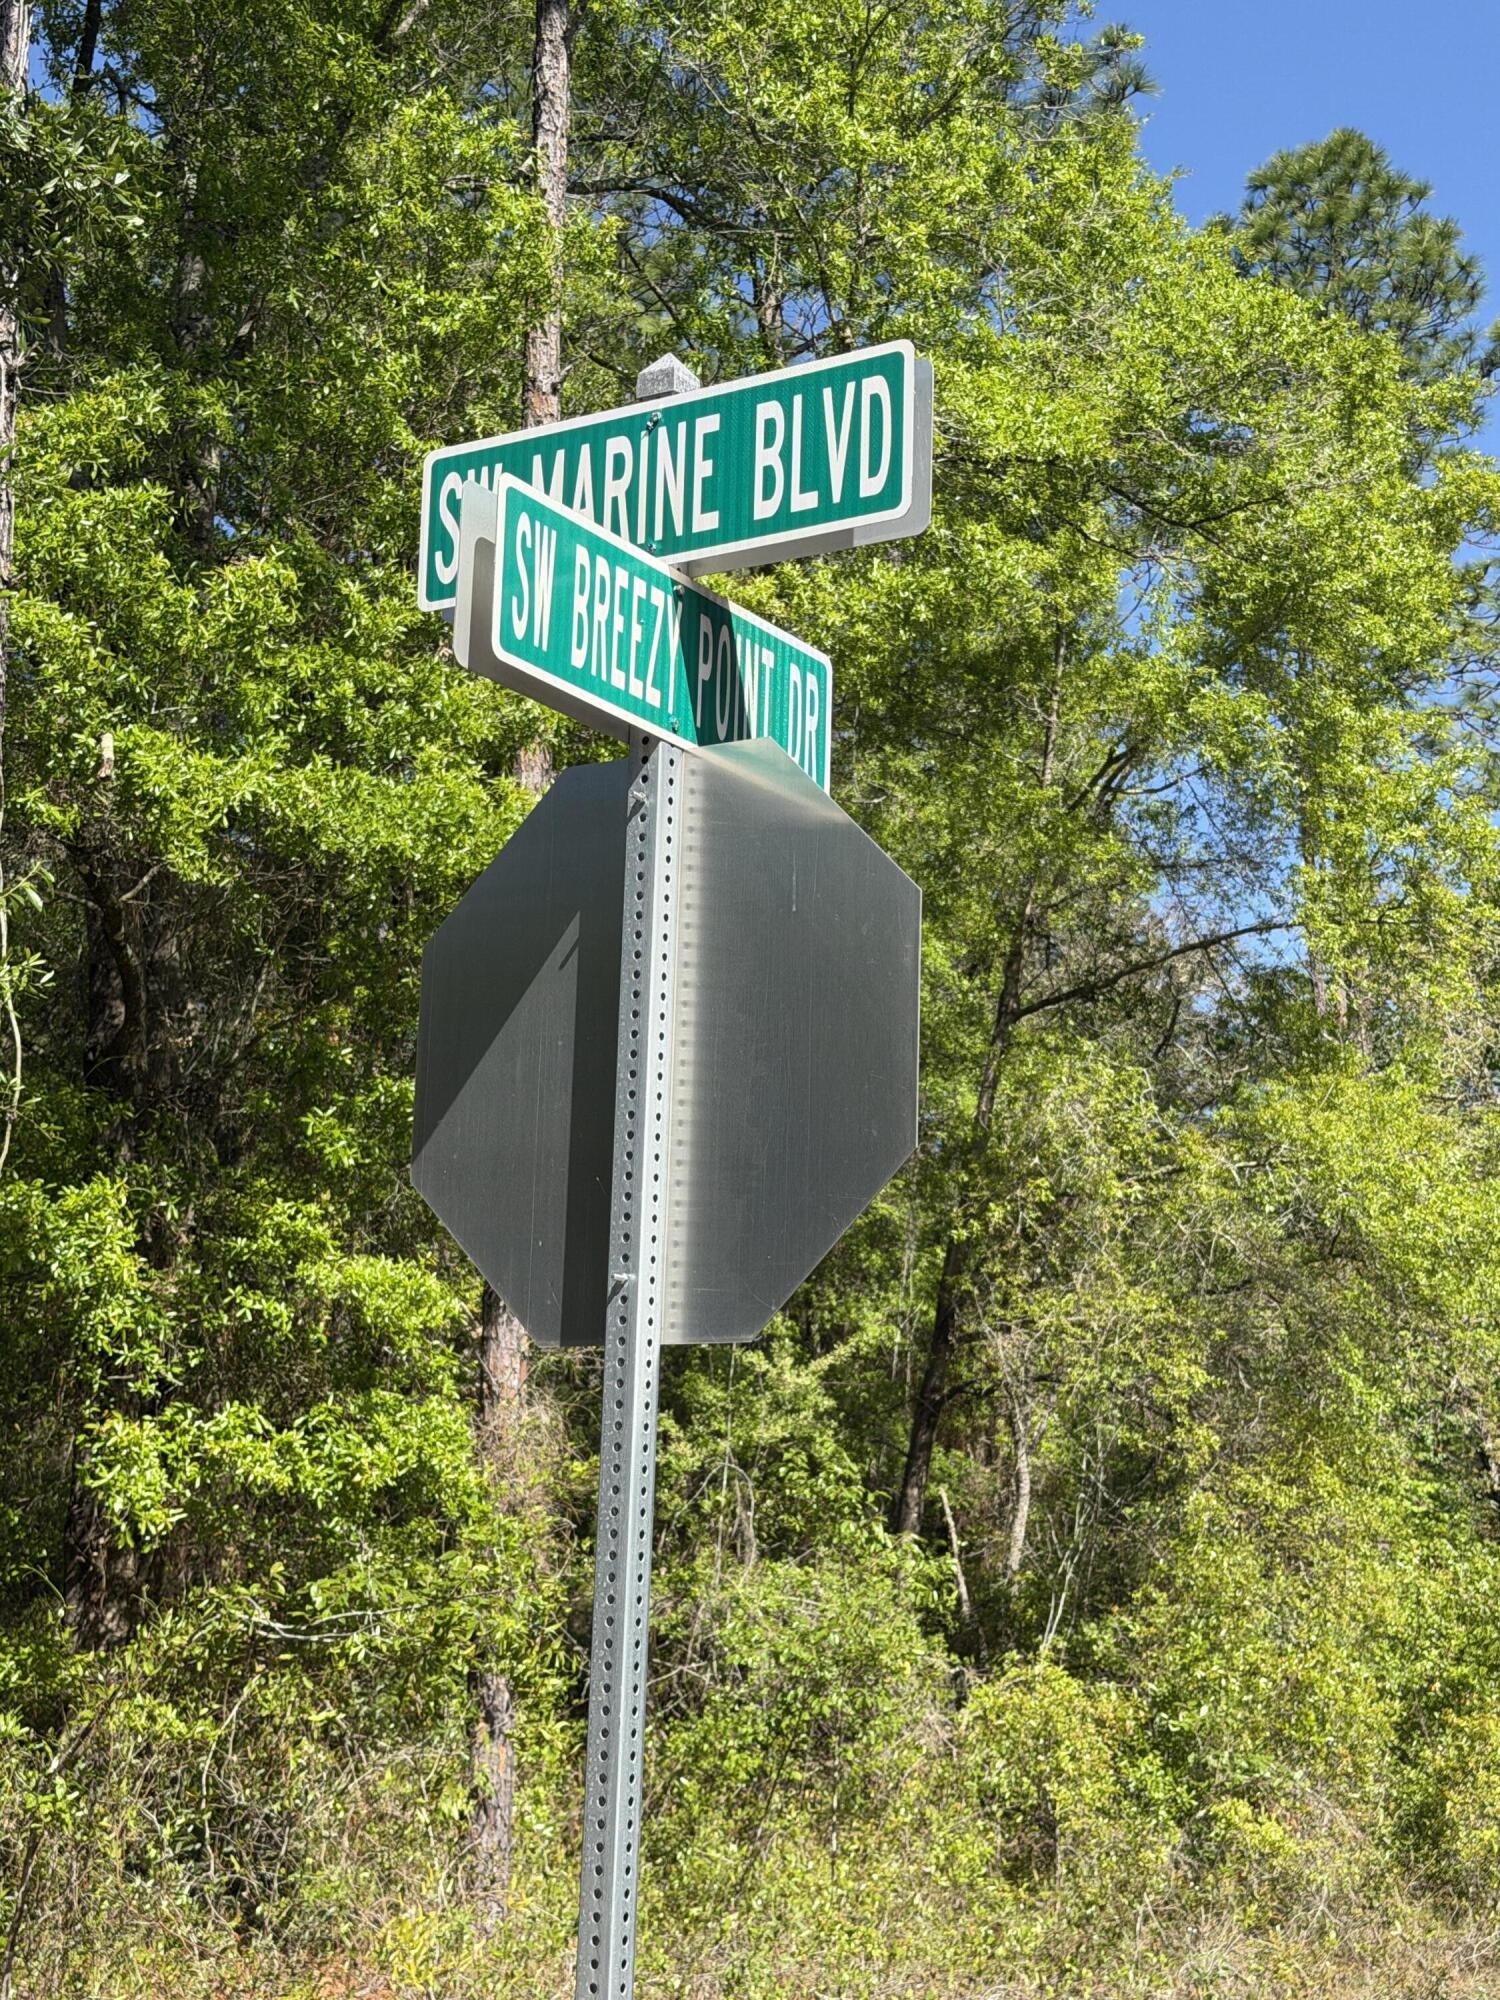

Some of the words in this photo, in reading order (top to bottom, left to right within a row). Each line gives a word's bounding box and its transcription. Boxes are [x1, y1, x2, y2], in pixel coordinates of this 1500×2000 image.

[753, 375, 892, 520] BLVD
[512, 512, 557, 651] SW
[571, 544, 682, 714] BREEZY
[697, 613, 775, 741] POINT
[787, 662, 819, 783] DR
